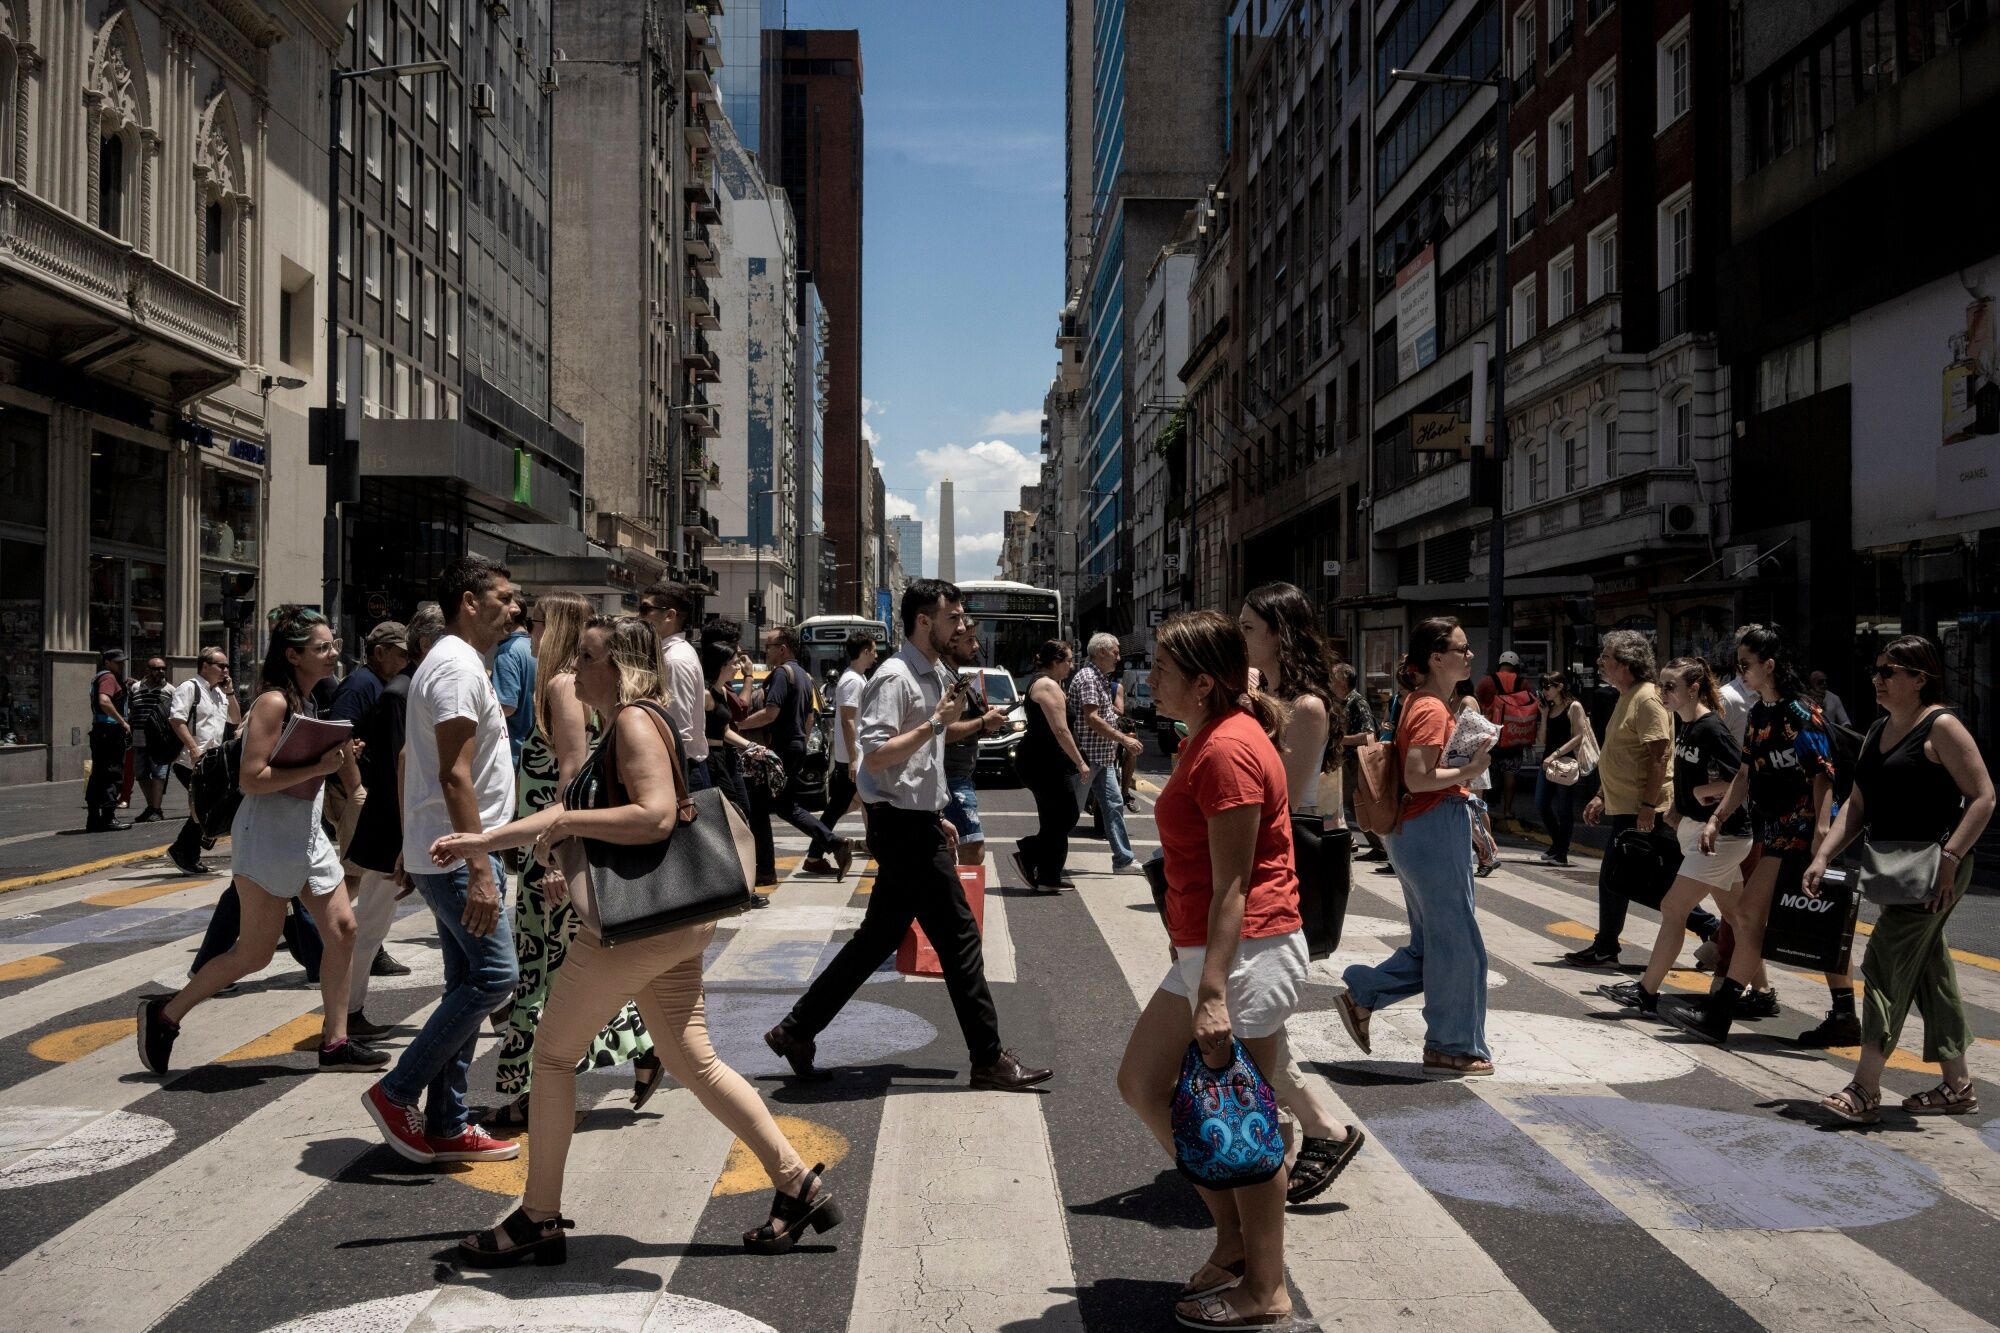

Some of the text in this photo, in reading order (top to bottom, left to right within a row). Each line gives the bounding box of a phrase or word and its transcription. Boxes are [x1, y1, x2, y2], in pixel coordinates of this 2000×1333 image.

[1416, 416, 1456, 445] Hotel
[1960, 468, 1988, 482] CHANEL
[1780, 893, 1836, 913] MOOV
